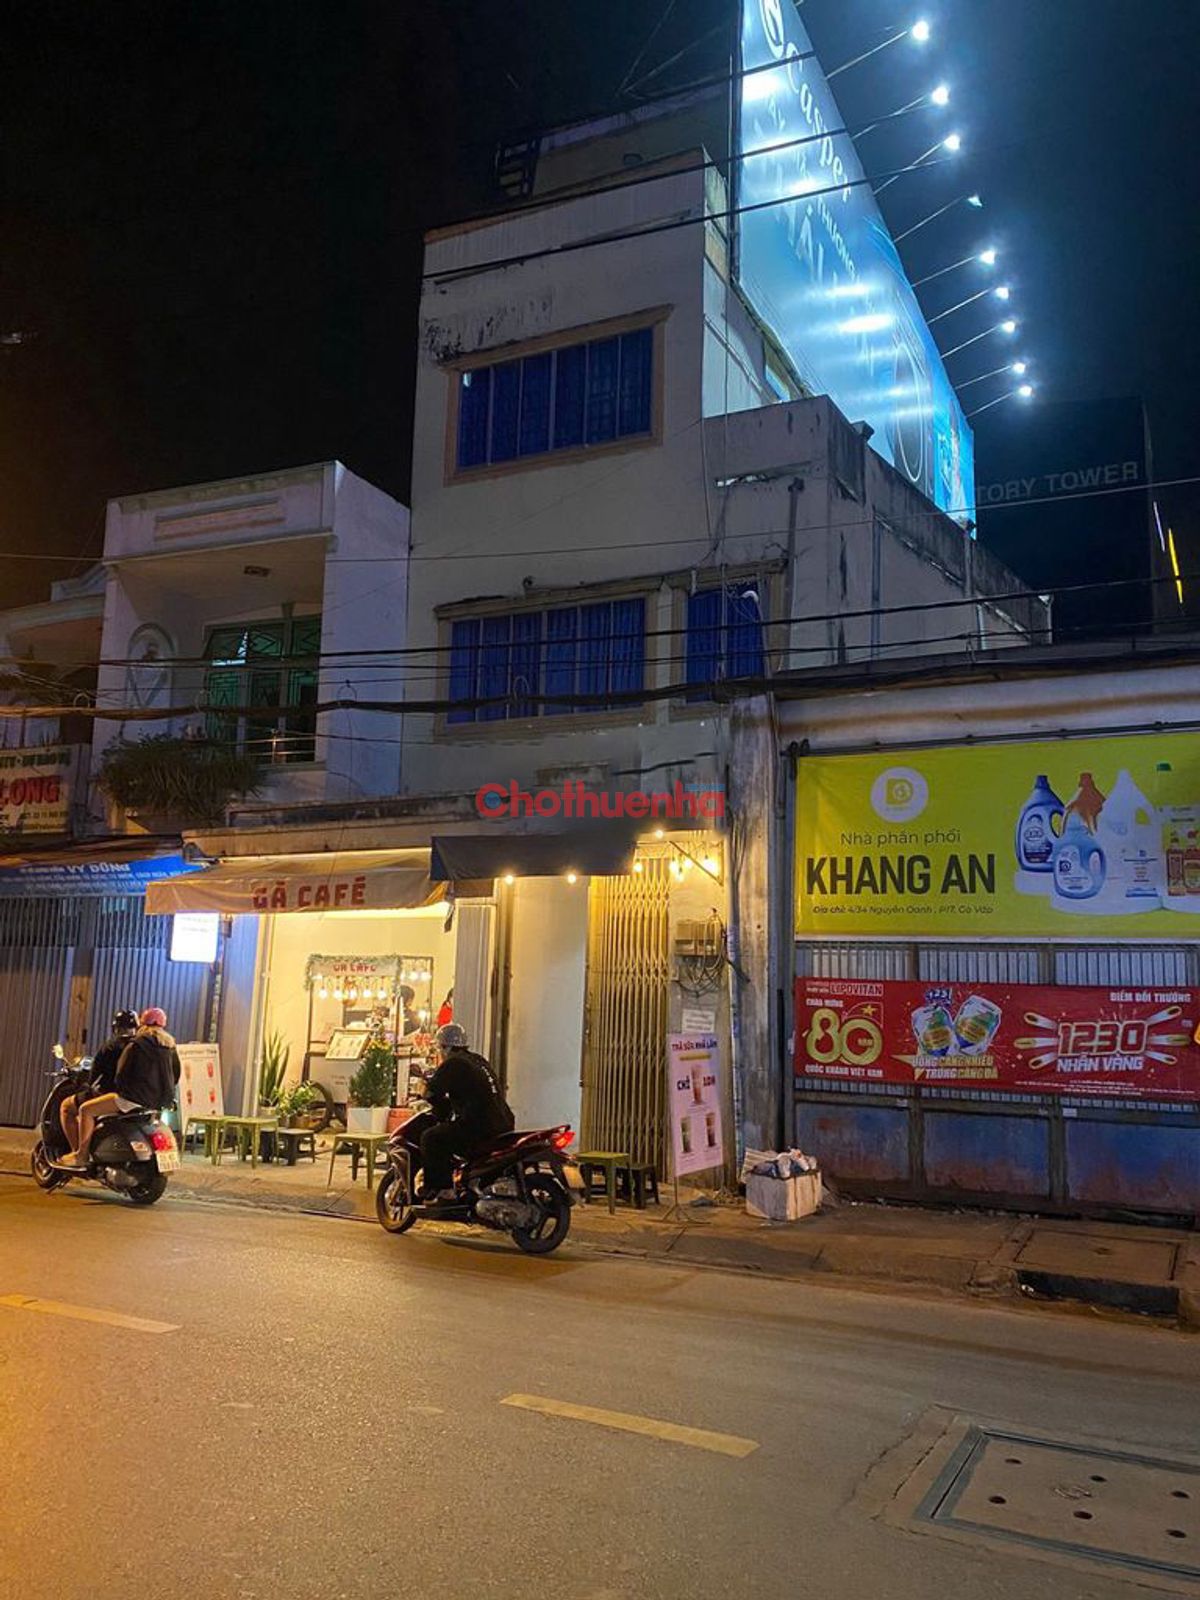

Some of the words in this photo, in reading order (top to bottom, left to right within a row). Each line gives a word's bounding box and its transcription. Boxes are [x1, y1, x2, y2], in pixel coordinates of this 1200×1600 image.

[1044, 461, 1139, 493] TOWER
[806, 854, 930, 895] KHANG
[942, 853, 996, 894] AN
[830, 983, 883, 997] LIPOVITAN
[805, 1007, 884, 1066] 80
[1058, 1020, 1148, 1056] 1230
